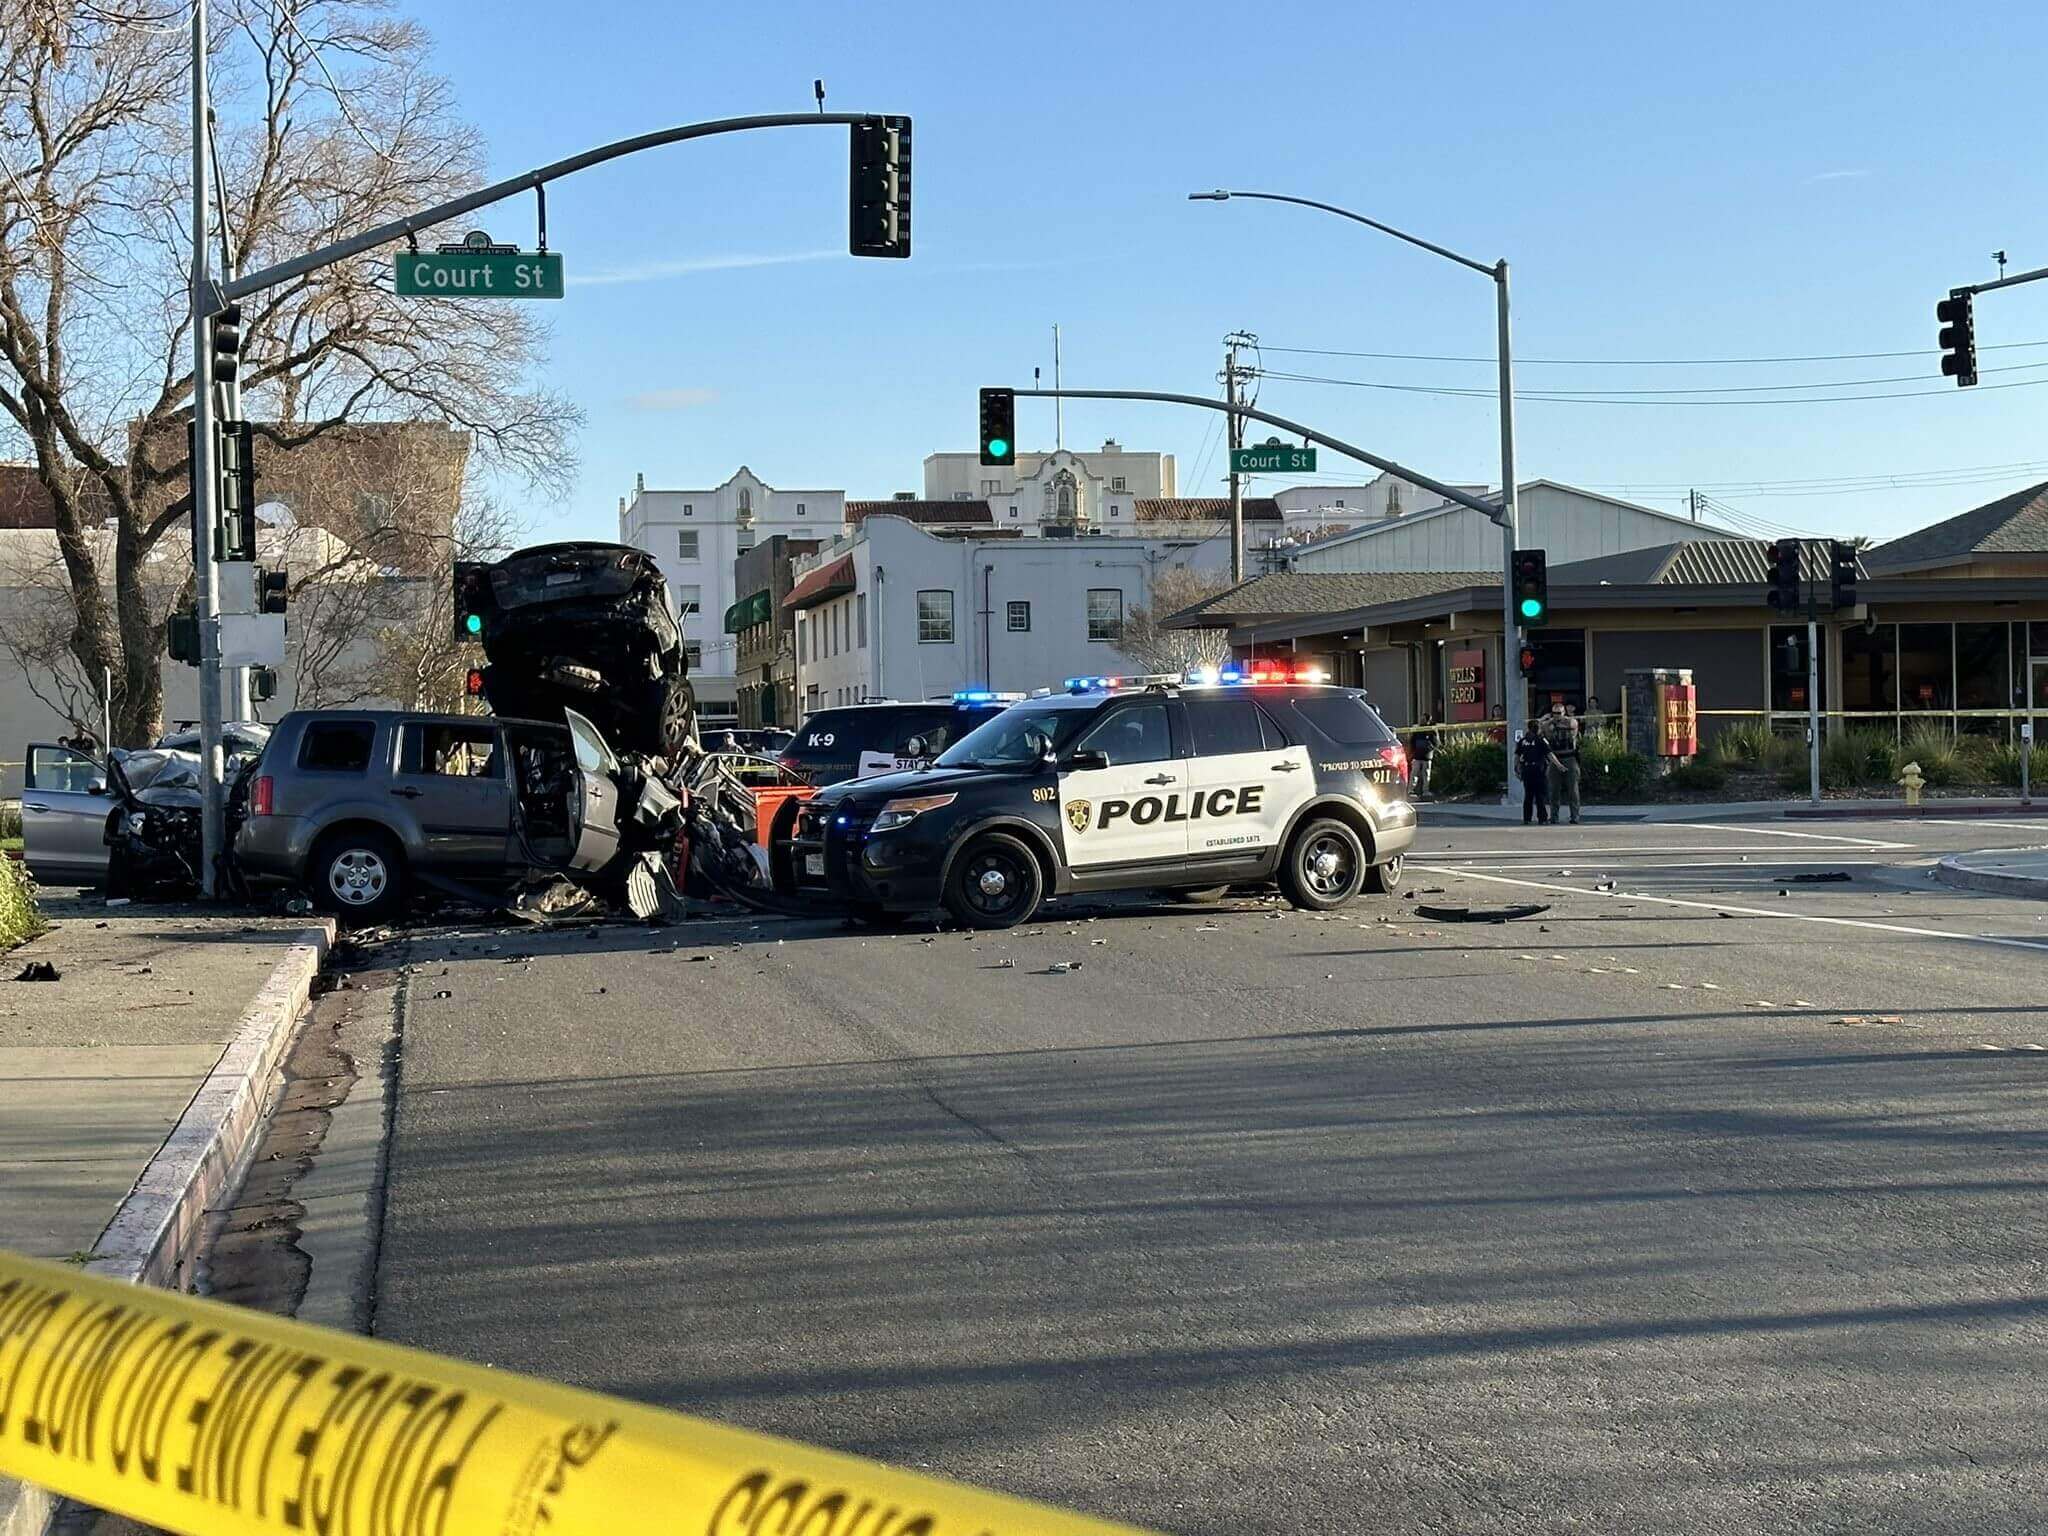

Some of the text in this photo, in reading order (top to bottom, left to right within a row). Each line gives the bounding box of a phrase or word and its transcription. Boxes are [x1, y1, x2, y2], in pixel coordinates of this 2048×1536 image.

[414, 263, 544, 288] Court St
[1240, 453, 1307, 468] Court St
[1450, 667, 1476, 683] WELLS
[1450, 687, 1476, 703] FARGO
[1665, 700, 1695, 718] WELLS
[1666, 720, 1696, 739] FARGO
[808, 733, 835, 747] K-9
[1373, 769, 1391, 784] 911
[1032, 787, 1056, 802] 802
[1097, 785, 1264, 829] POLICE
